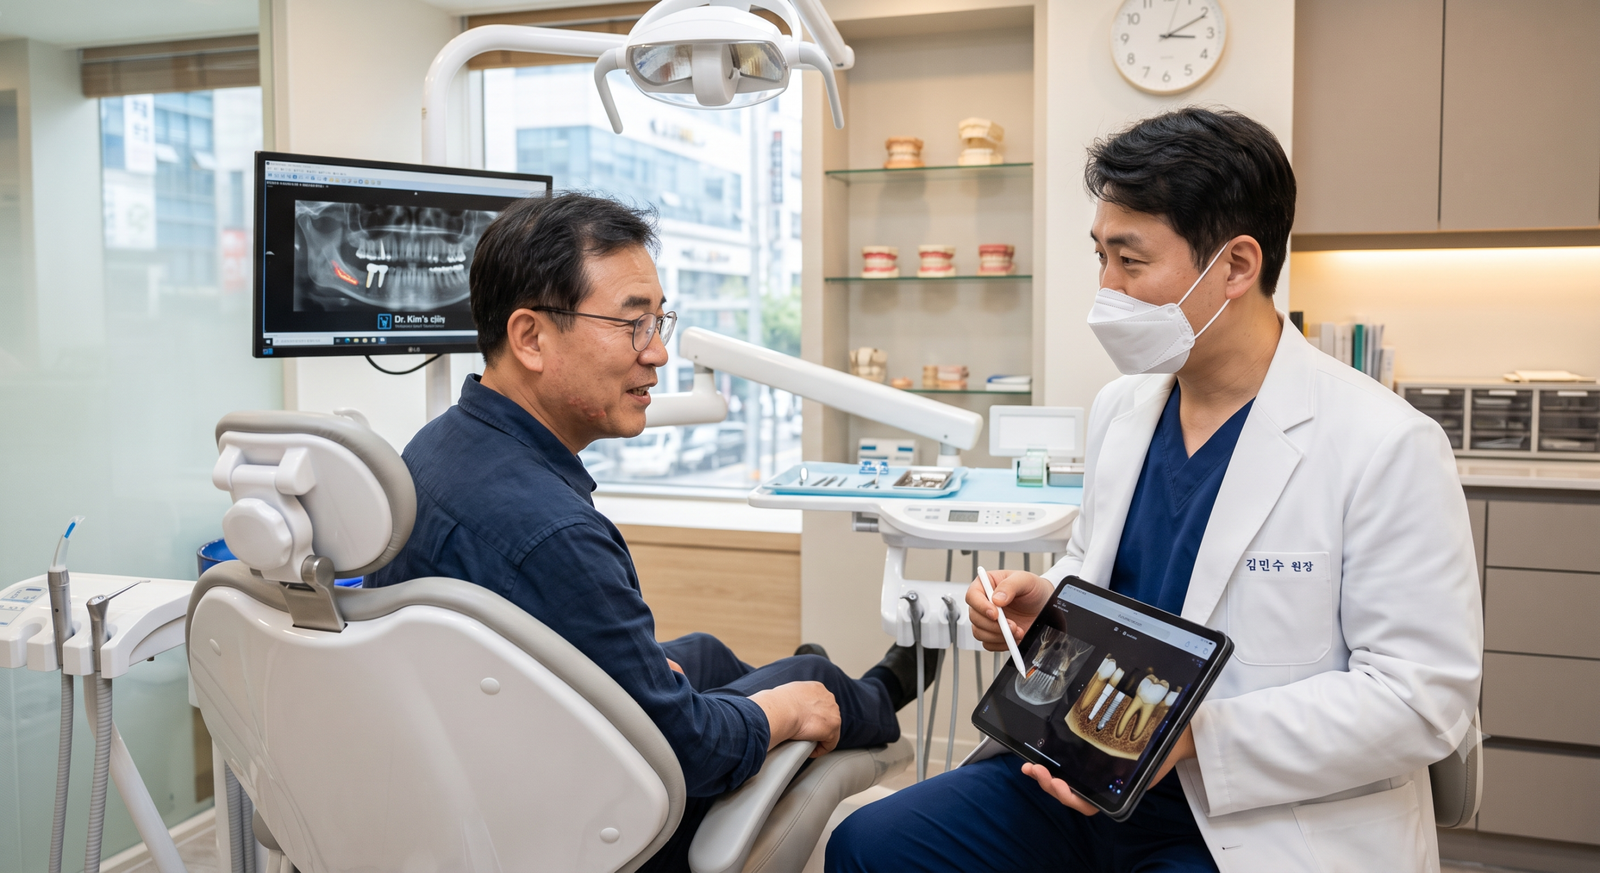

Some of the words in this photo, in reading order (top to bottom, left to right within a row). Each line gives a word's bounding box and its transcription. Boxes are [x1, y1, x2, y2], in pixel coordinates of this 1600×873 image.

[1127, 12, 1141, 25] 10
[1200, 6, 1209, 19] 2
[1120, 33, 1130, 45] 9
[1206, 26, 1215, 39] 3
[1126, 52, 1136, 65] 8
[1200, 48, 1208, 59] 4
[1142, 66, 1151, 78] 7
[1162, 70, 1171, 83] 6
[1184, 64, 1193, 76] 5
[394, 315, 406, 323] Dr.
[407, 315, 429, 323] Kim's
[1246, 558, 1285, 572] 김민수
[1291, 561, 1314, 572] 원장
